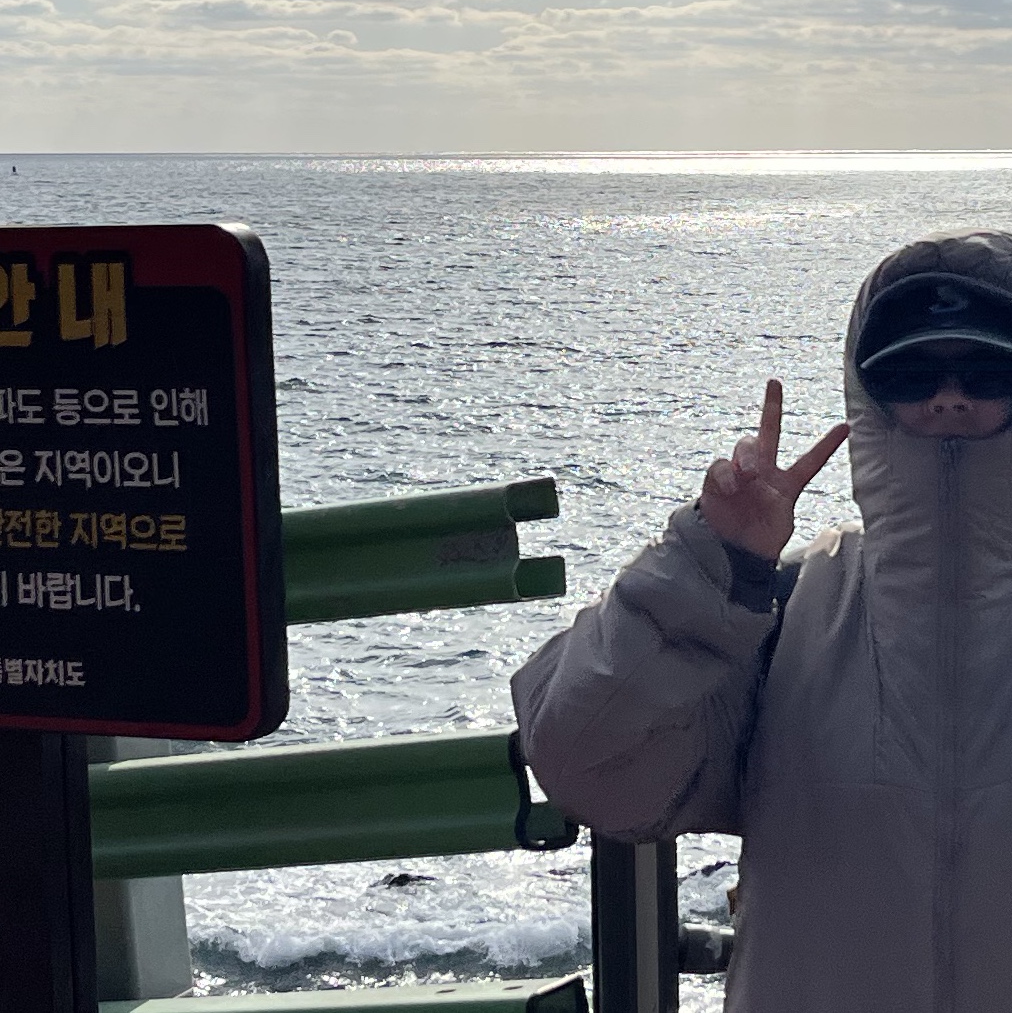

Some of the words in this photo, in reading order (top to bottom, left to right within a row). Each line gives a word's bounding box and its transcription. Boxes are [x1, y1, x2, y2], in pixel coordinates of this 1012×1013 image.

[53, 388, 141, 426] 등으로
[150, 388, 209, 426] 인해
[34, 449, 180, 489] 지역이오니
[0, 509, 62, 549] 전한
[69, 512, 188, 551] 지역으로
[18, 571, 141, 612] 바랍니다.
